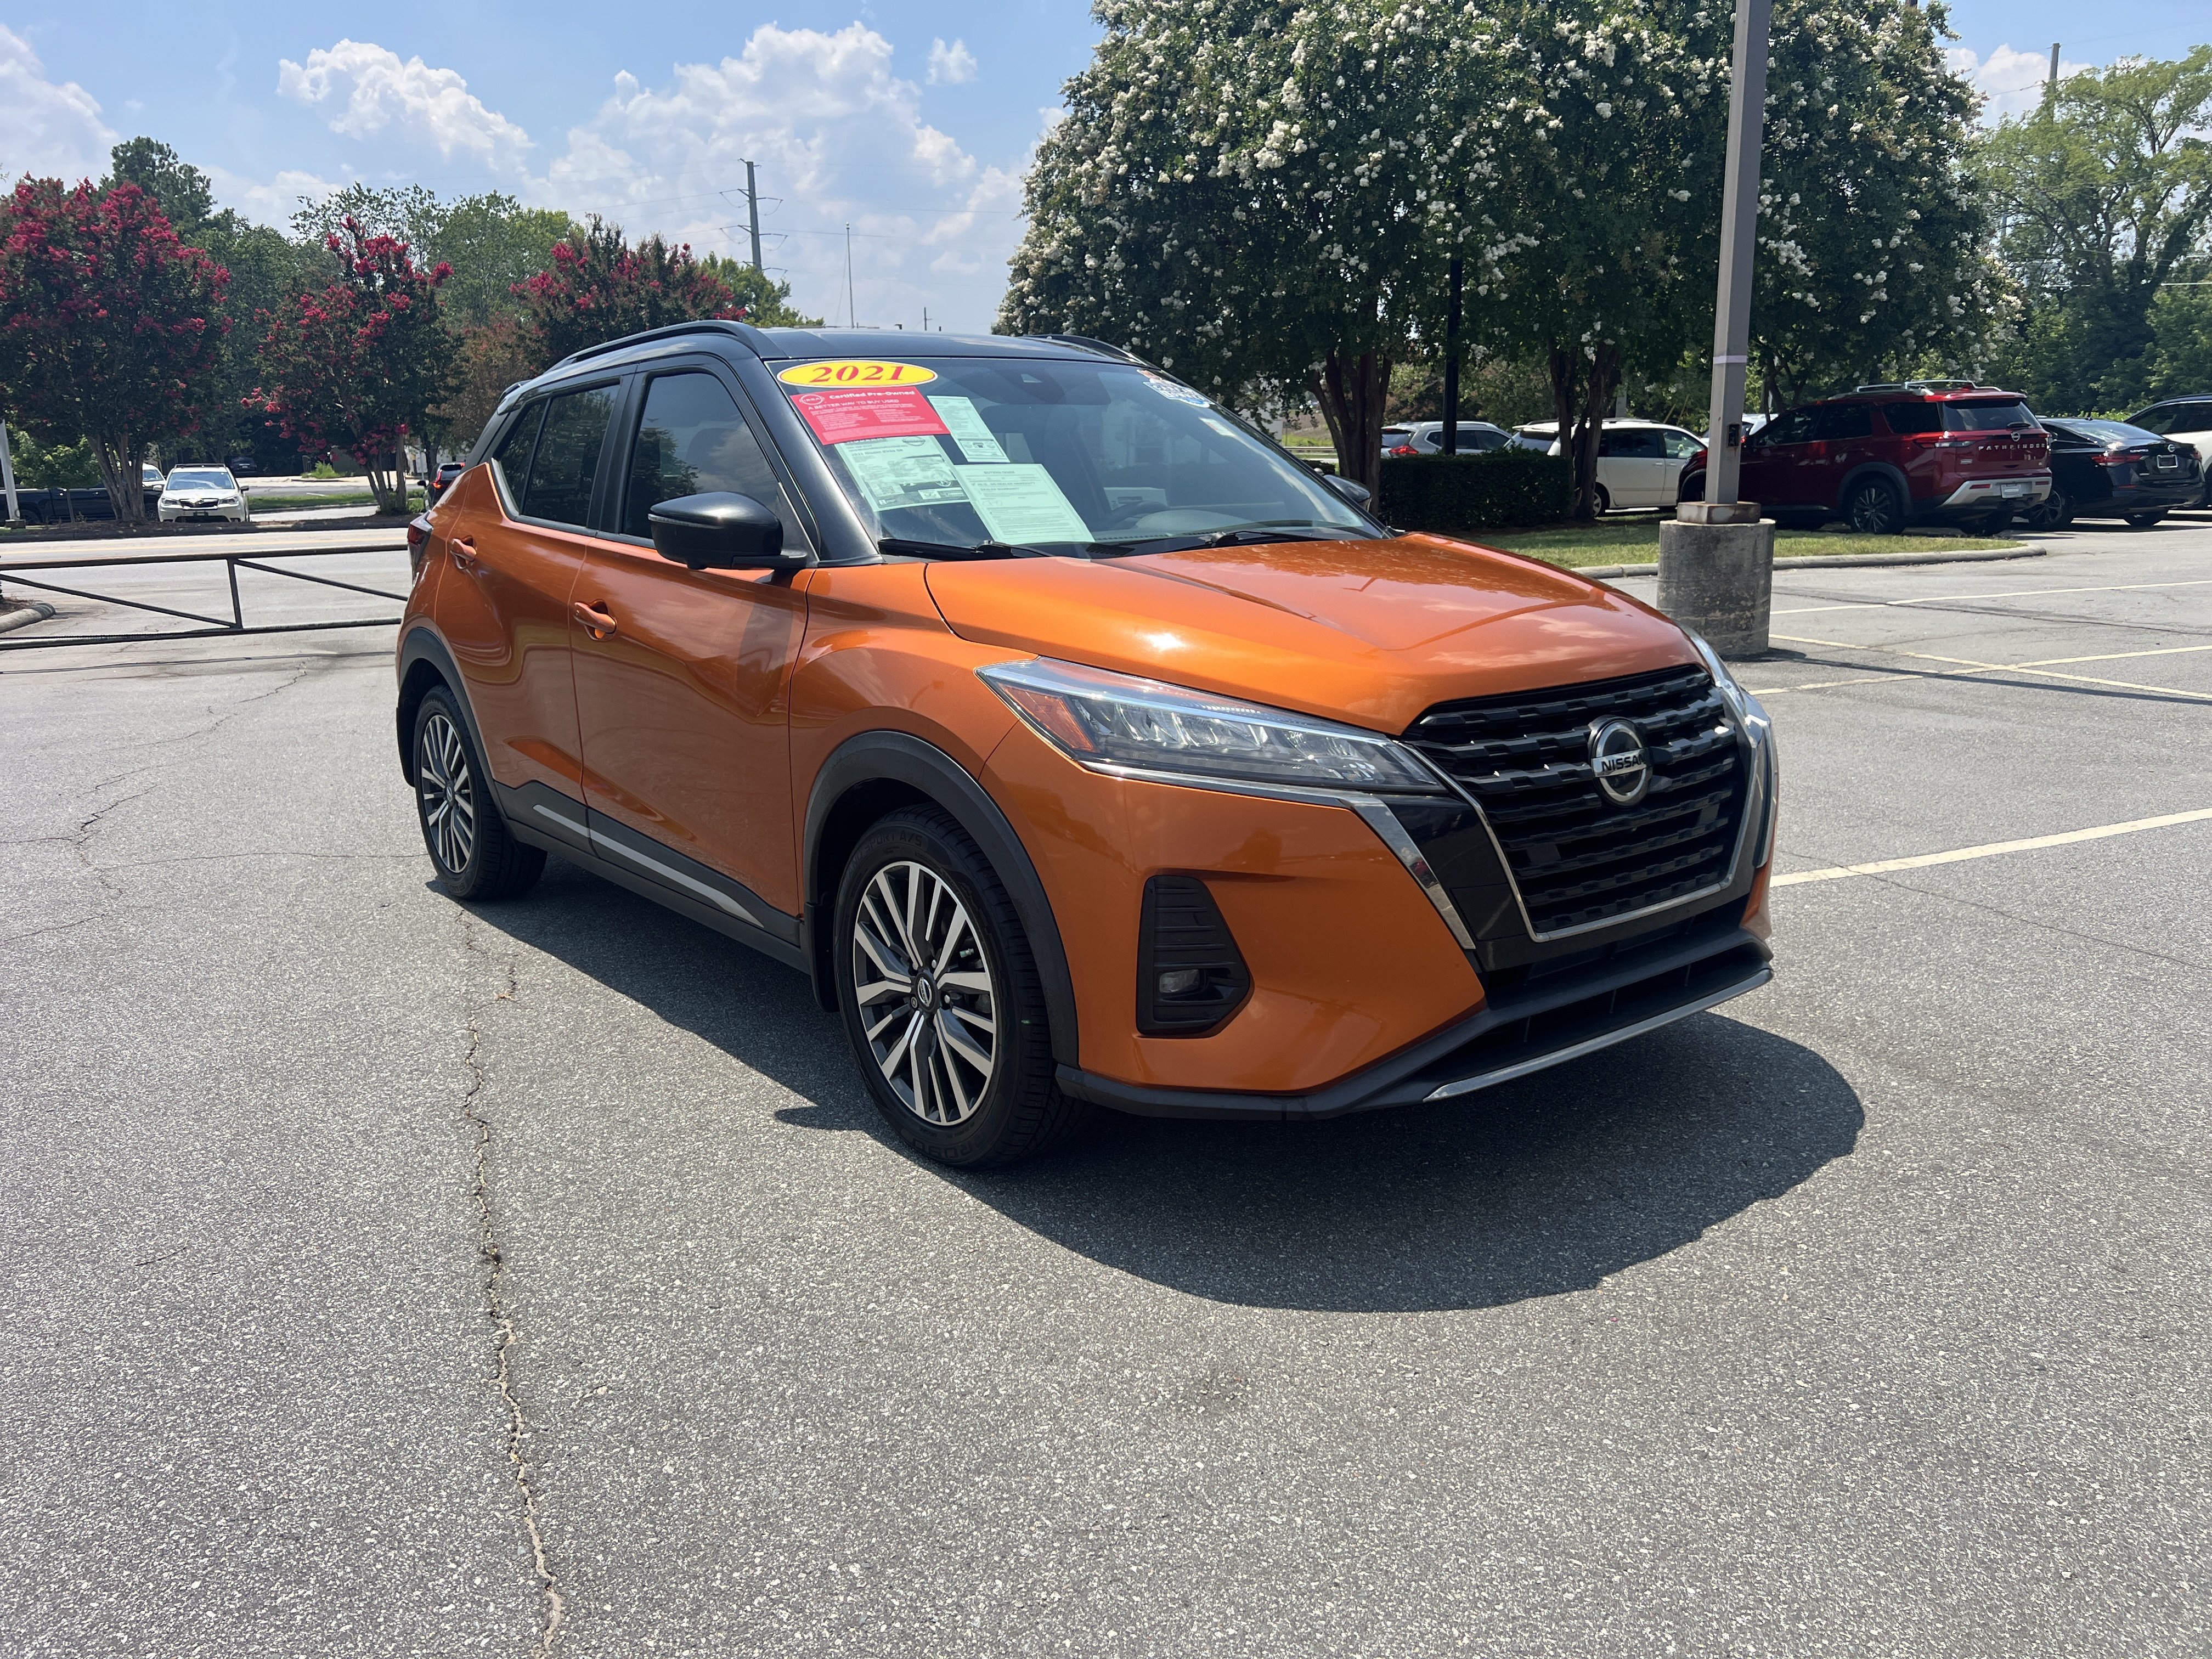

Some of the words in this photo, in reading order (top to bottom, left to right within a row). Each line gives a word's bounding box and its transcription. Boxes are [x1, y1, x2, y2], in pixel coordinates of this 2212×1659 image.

[809, 365, 904, 383] 2021
[1601, 754, 1646, 772] NISSAN
[899, 830, 923, 848] A/S
